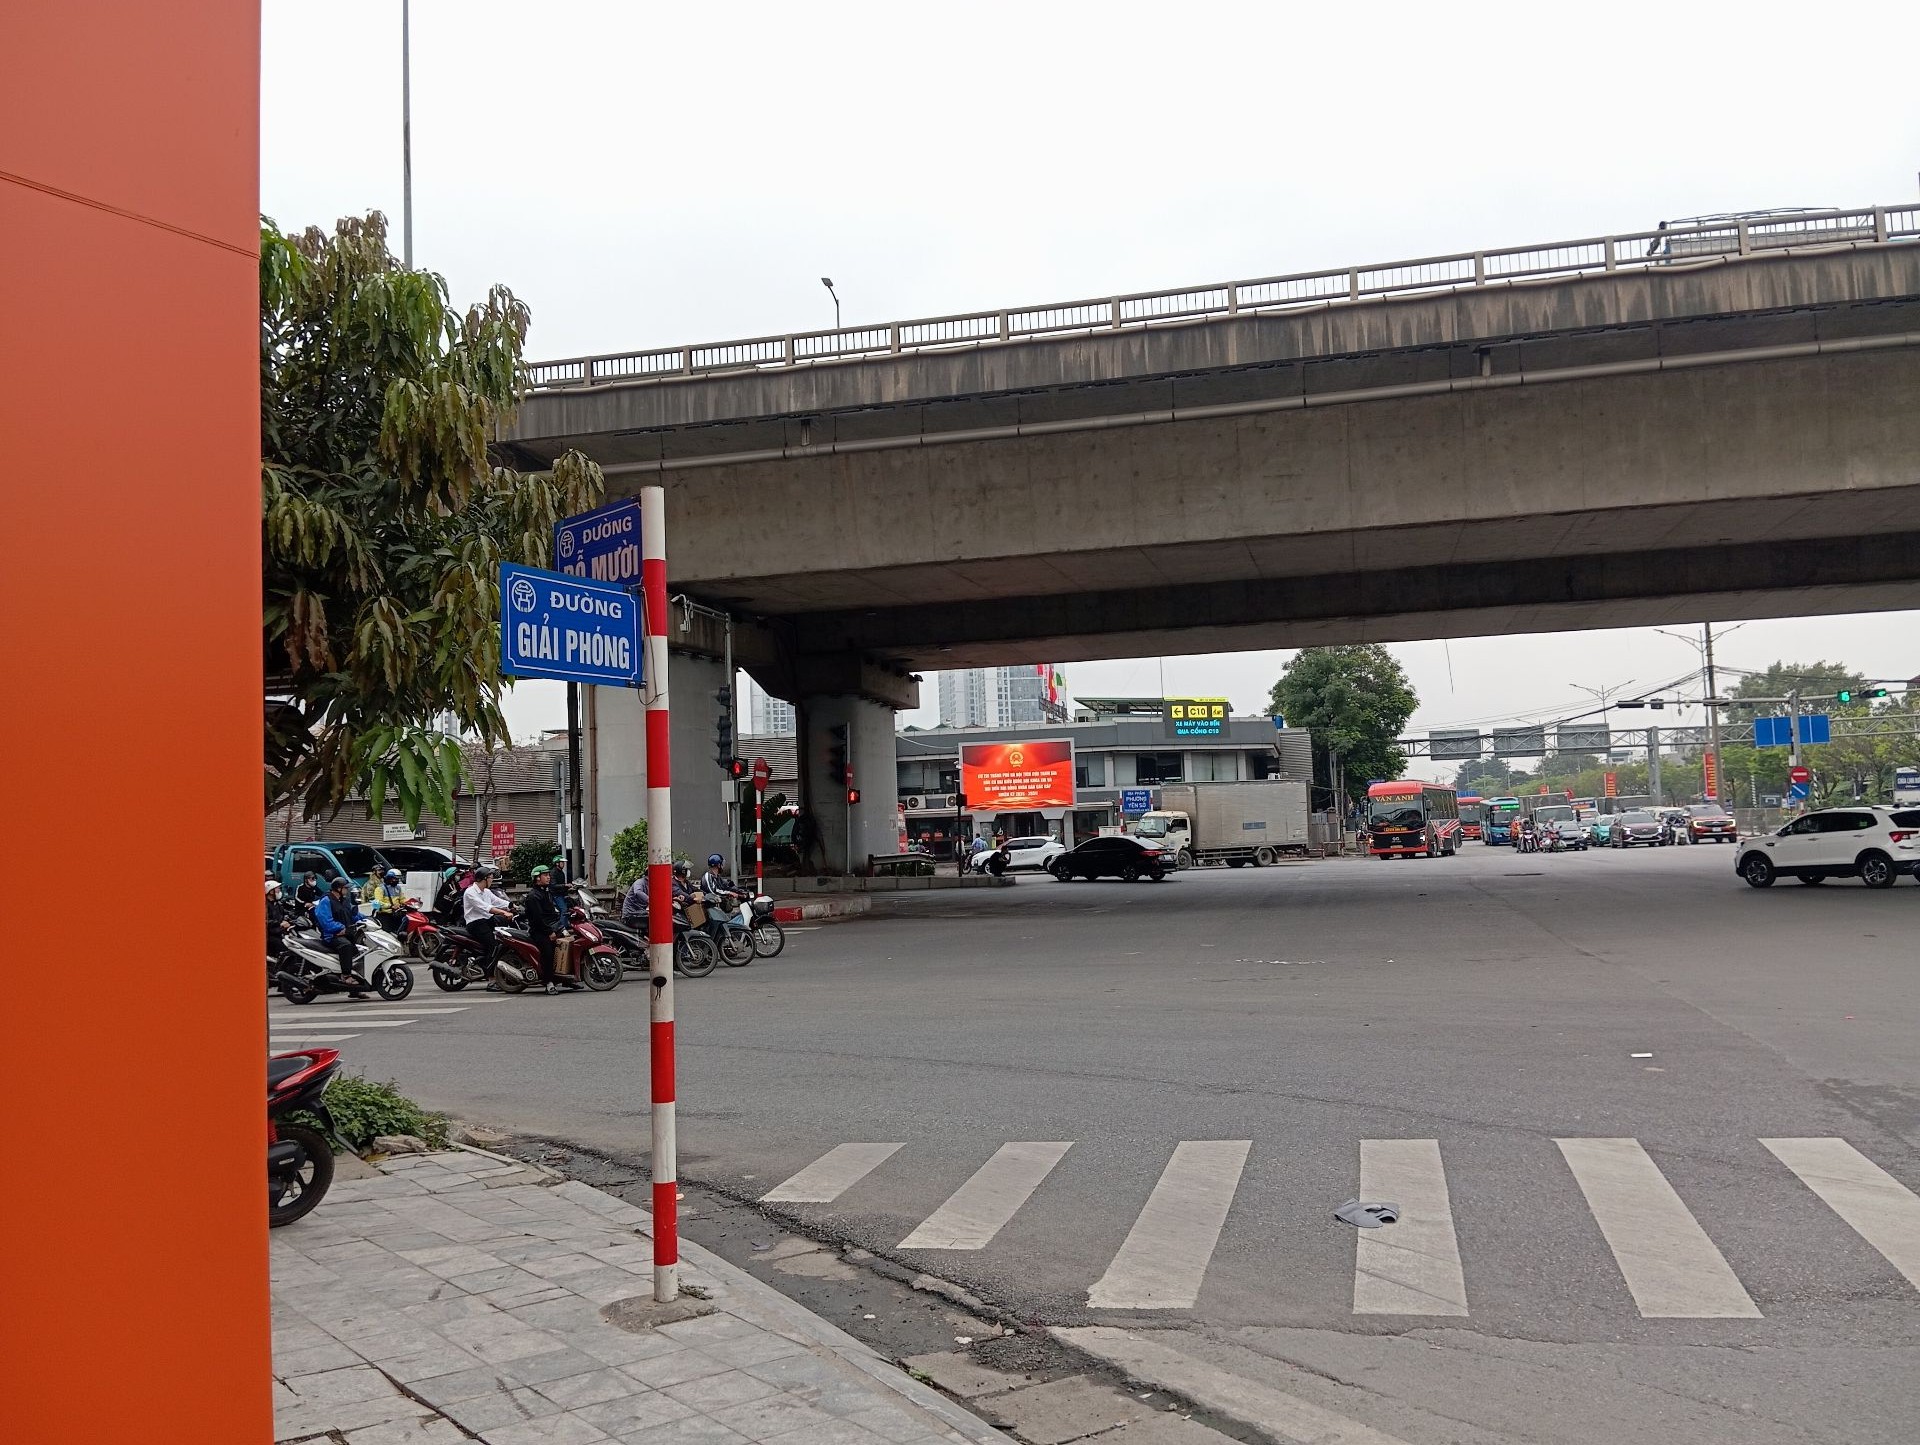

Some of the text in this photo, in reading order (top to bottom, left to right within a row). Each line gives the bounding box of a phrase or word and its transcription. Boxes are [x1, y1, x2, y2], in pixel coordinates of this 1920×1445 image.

[583, 516, 632, 544] ĐƯỜNG
[591, 539, 639, 582] MƯỜI
[550, 591, 622, 619] ĐƯỜNG
[517, 612, 630, 670] GIẢI PHÓNG
[1190, 708, 1206, 716] C10
[1395, 794, 1414, 802] ANH
